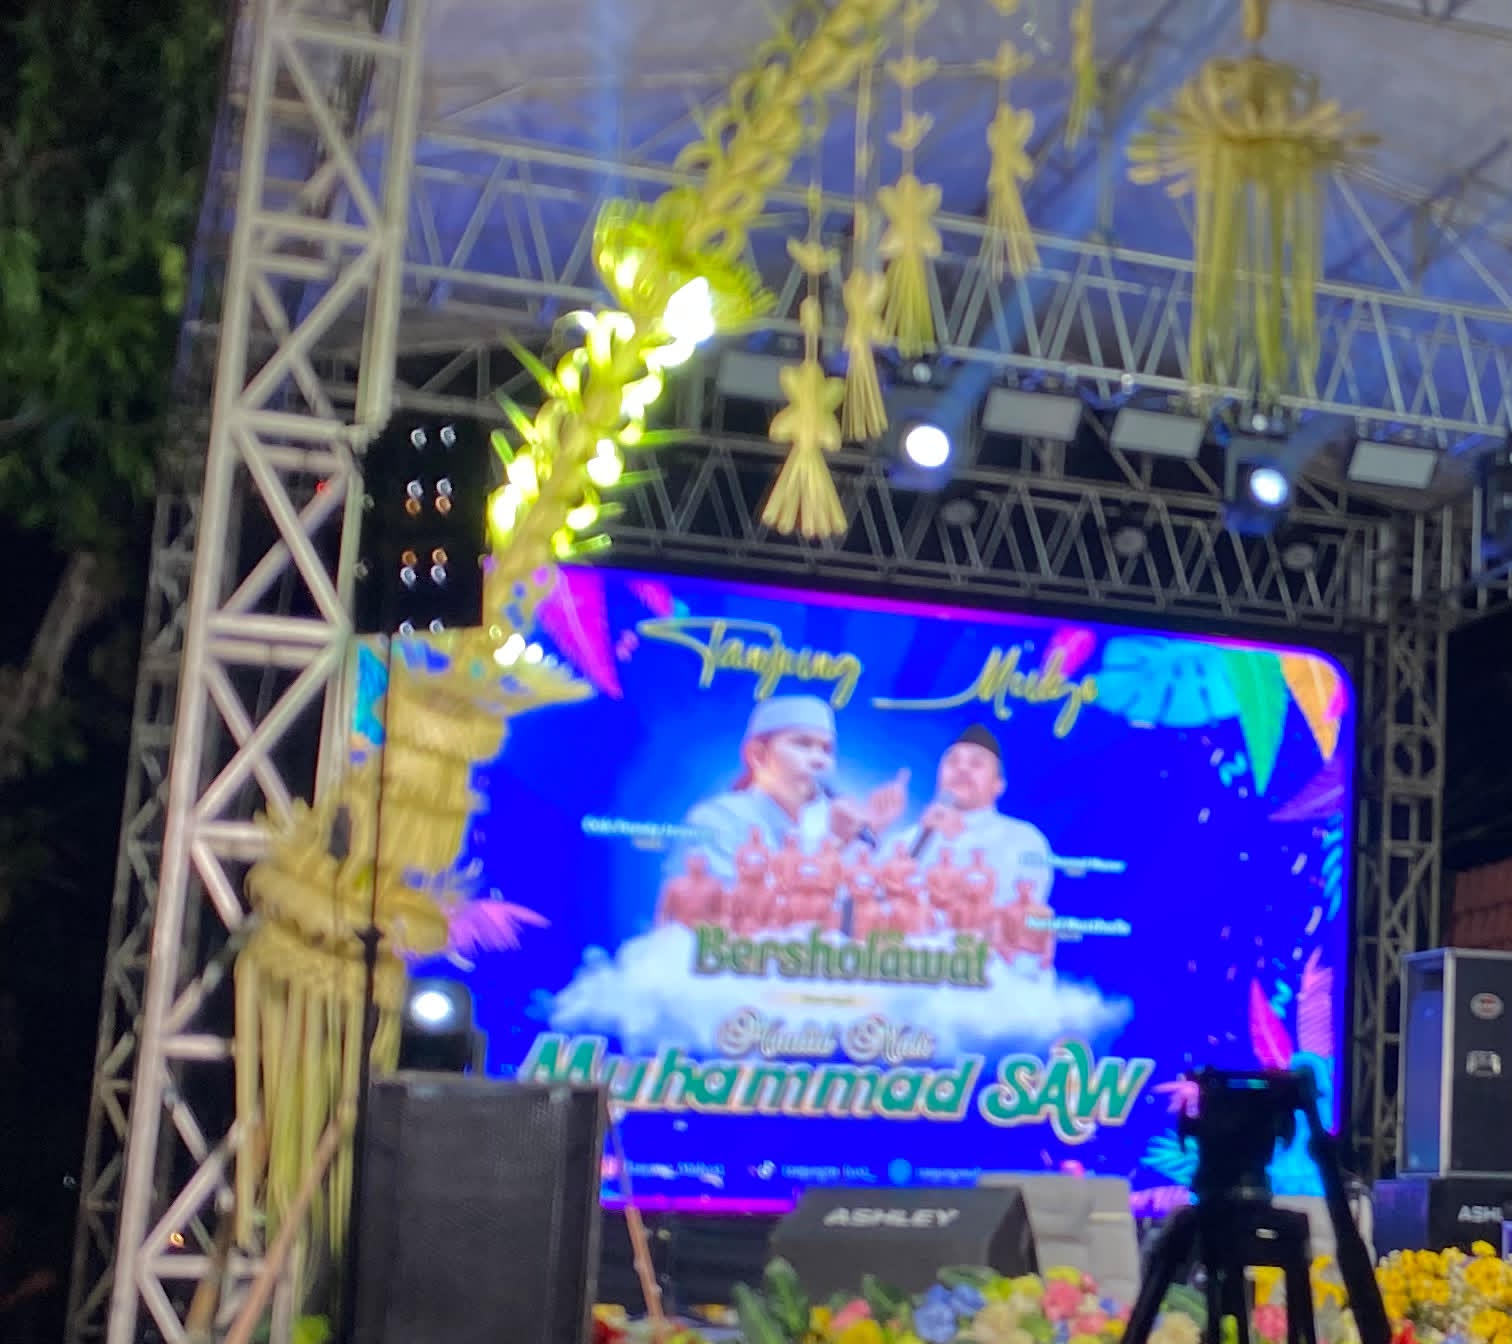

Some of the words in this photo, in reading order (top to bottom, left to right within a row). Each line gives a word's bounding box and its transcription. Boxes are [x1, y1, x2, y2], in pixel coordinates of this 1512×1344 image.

[516, 1032, 984, 1119] Muhammad
[978, 1039, 1154, 1145] SAW
[823, 1206, 960, 1228] ASHLEY
